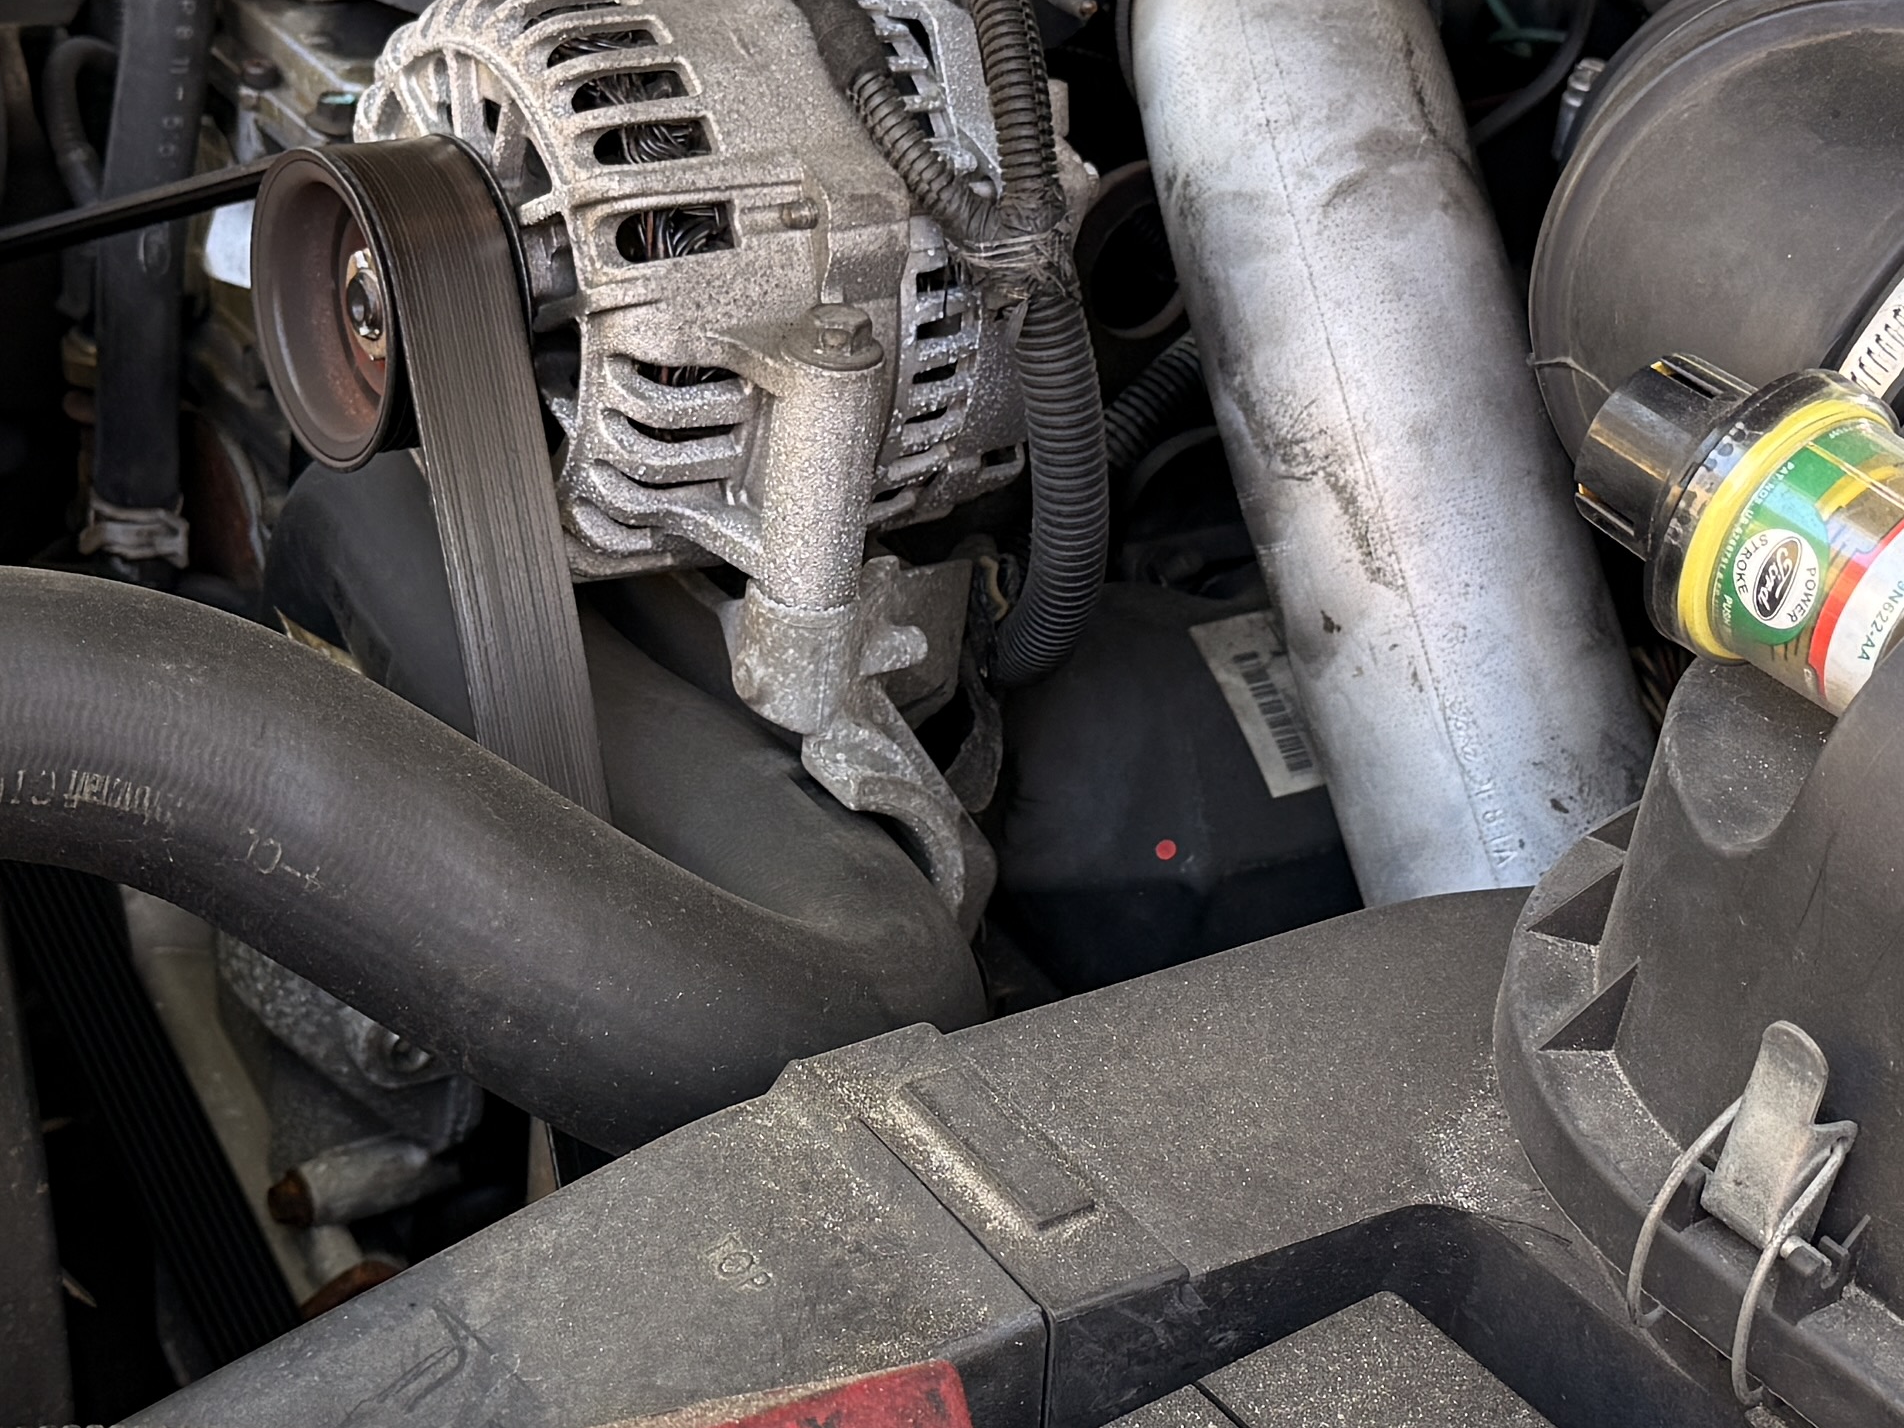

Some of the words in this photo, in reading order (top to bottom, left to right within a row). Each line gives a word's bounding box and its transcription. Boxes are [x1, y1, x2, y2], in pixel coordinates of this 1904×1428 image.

[1737, 533, 1769, 596] STROKE
[1754, 541, 1801, 614] Ford
[1787, 567, 1817, 622] POWER
